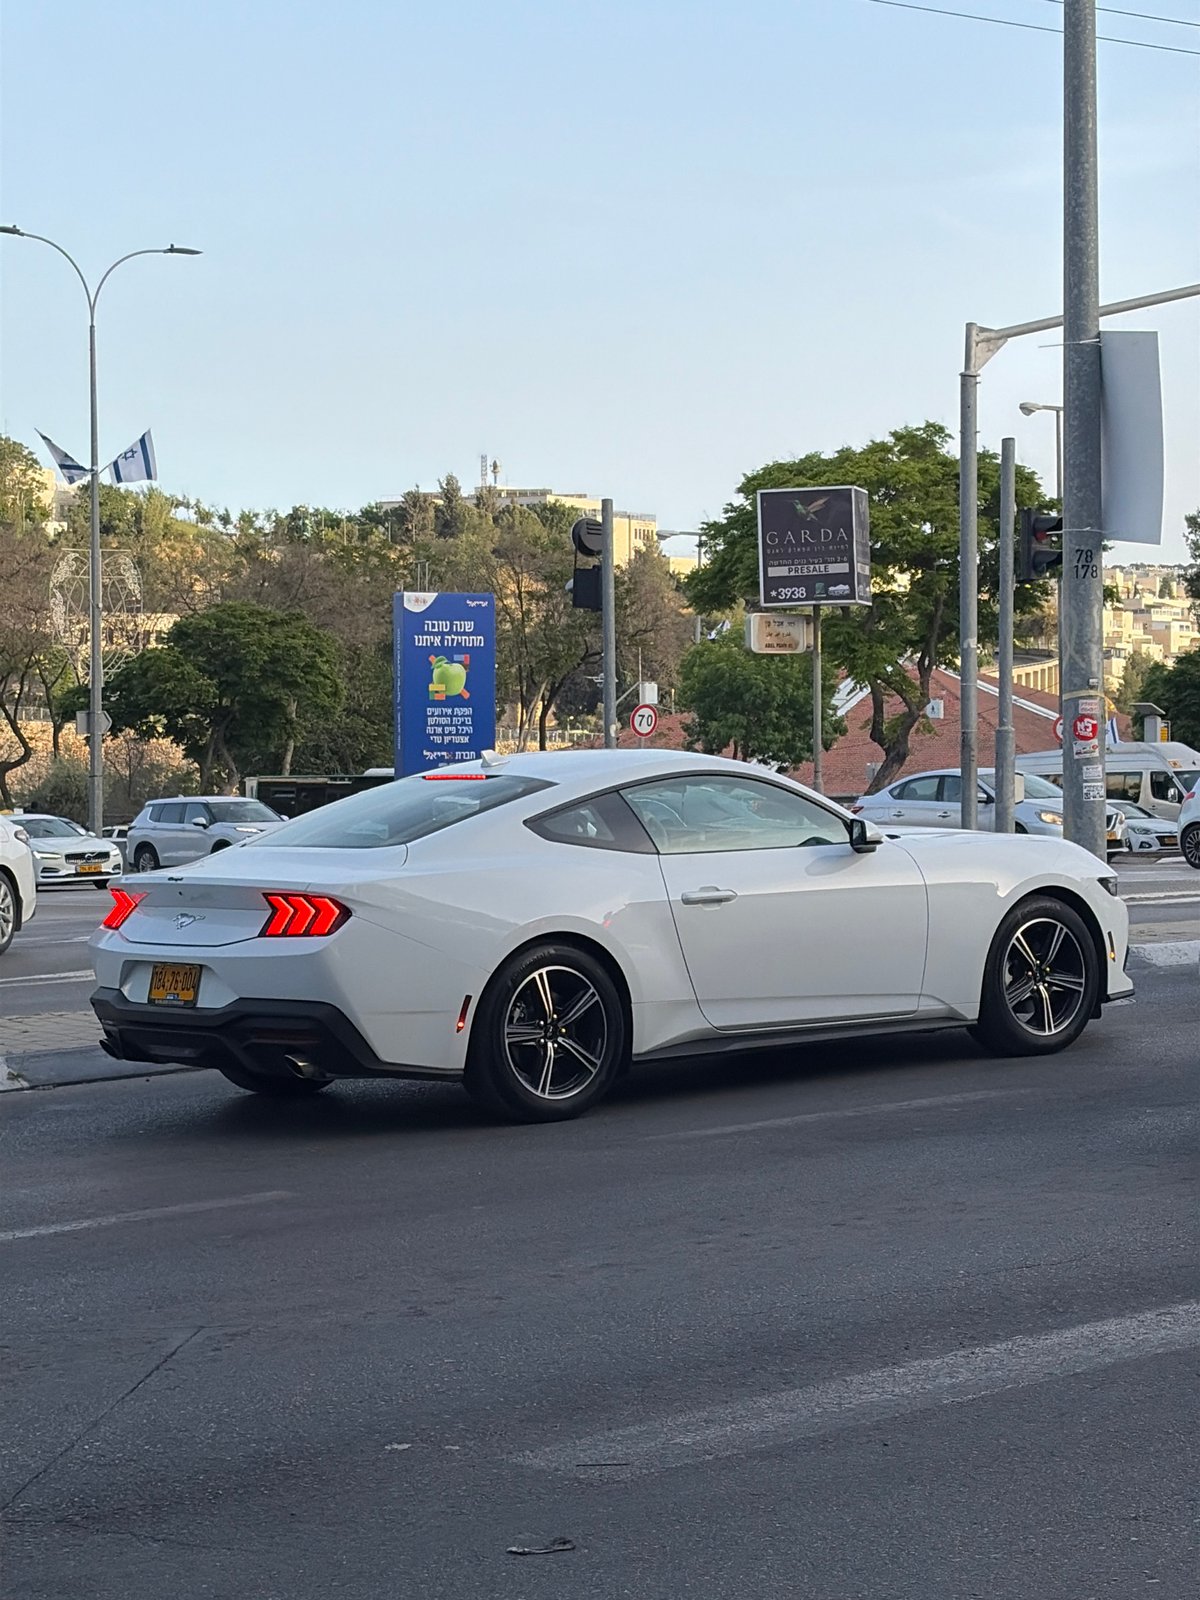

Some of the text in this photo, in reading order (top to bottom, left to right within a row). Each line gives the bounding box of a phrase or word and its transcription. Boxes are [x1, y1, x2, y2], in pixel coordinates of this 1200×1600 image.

[766, 528, 848, 545] GARDA
[1076, 549, 1093, 563] 78
[788, 565, 830, 575] PRESALE
[1074, 564, 1098, 579] 178
[425, 620, 474, 632] שנה טובה
[414, 635, 484, 647] מתחילה איתנו
[427, 707, 472, 716] הפקת אירועים
[428, 717, 451, 725] הסולטן
[638, 714, 653, 727] 70
[444, 736, 470, 744] אצטדיון
[455, 751, 476, 759] חברת
